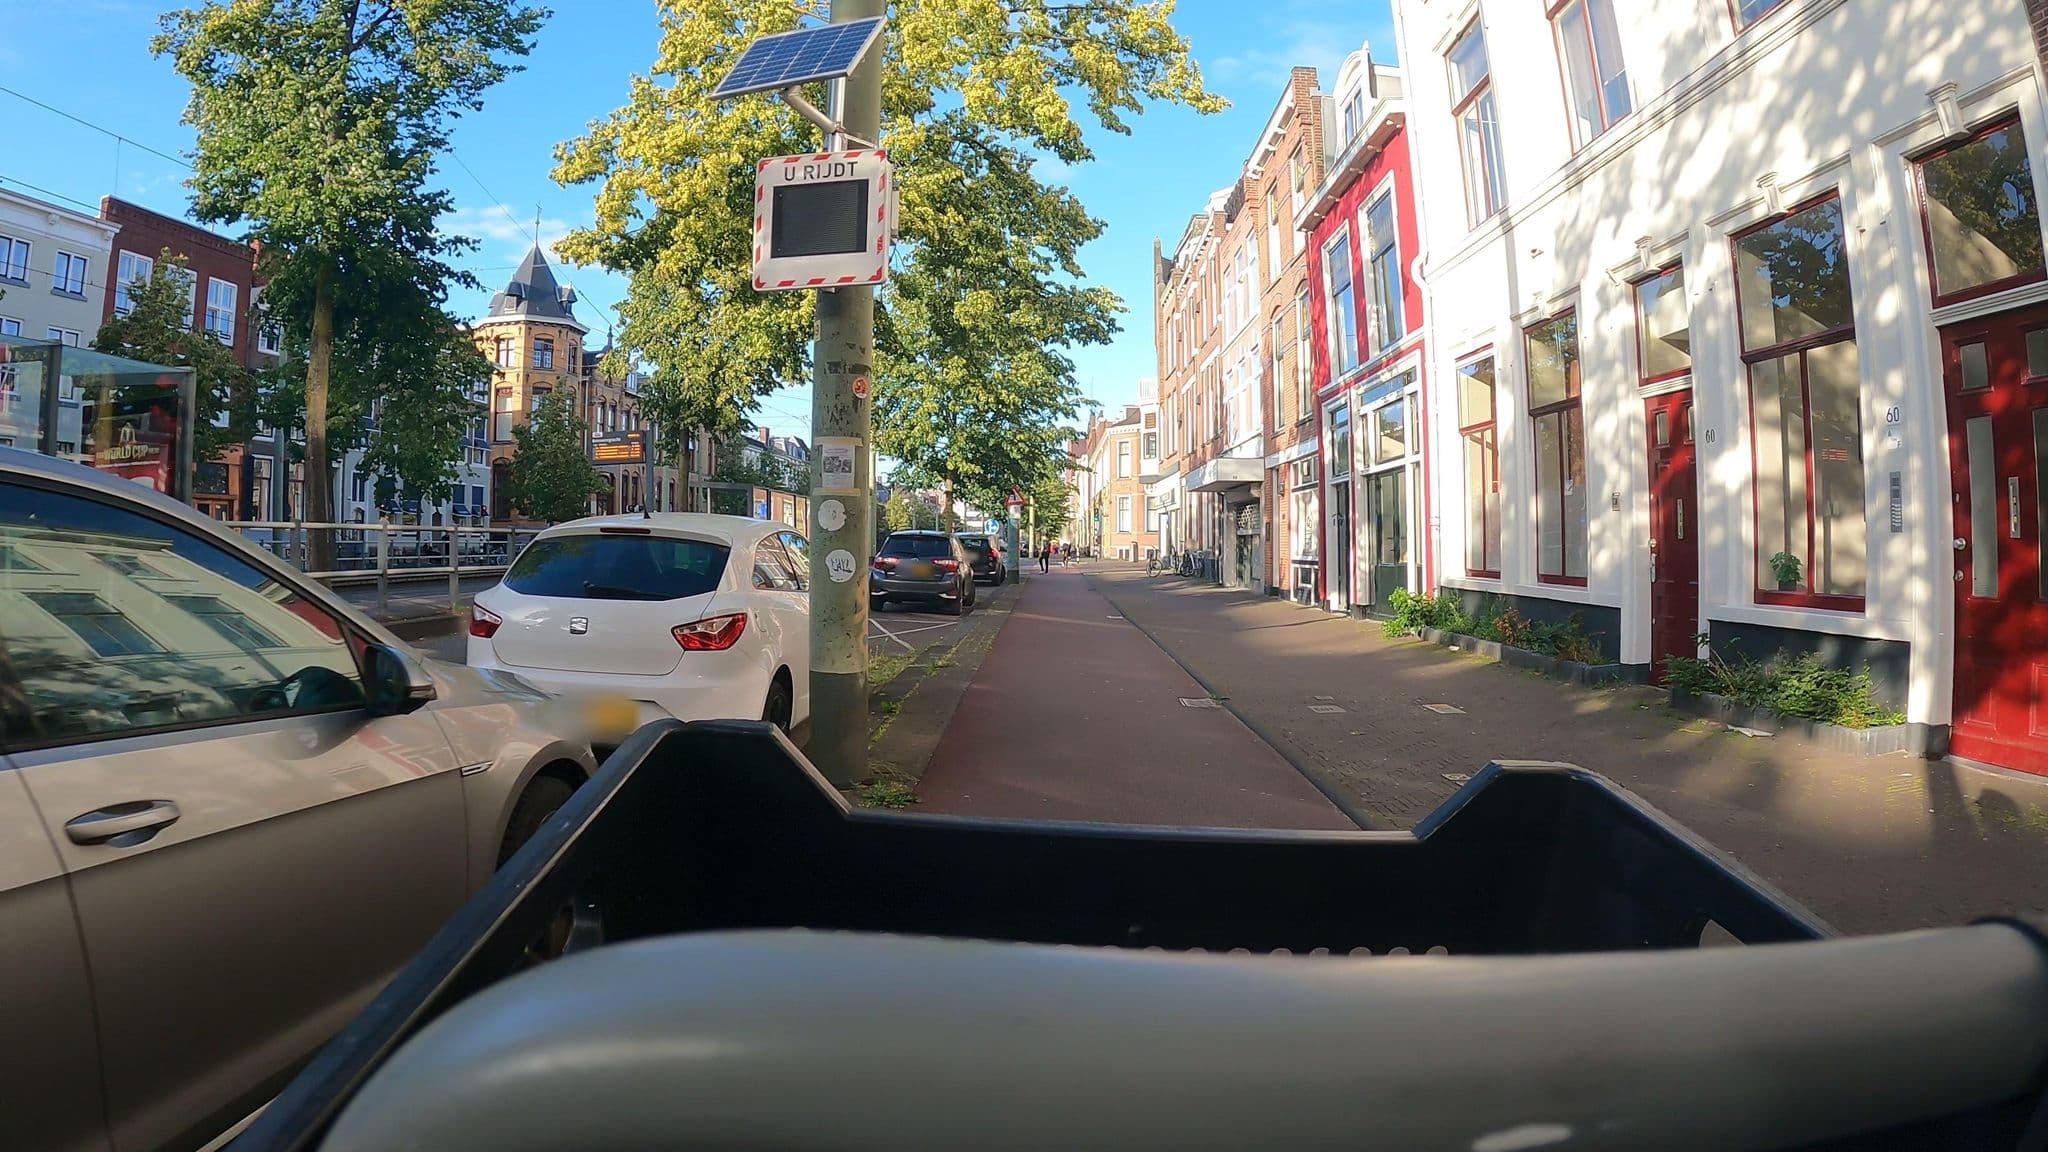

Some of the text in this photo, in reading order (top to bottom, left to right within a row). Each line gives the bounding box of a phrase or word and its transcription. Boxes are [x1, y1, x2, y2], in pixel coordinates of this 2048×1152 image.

[784, 161, 859, 182] U RIJDT
[1886, 406, 1900, 423] 60
[1705, 428, 1716, 443] 60
[104, 445, 131, 460] WORLD
[132, 444, 149, 459] CUP
